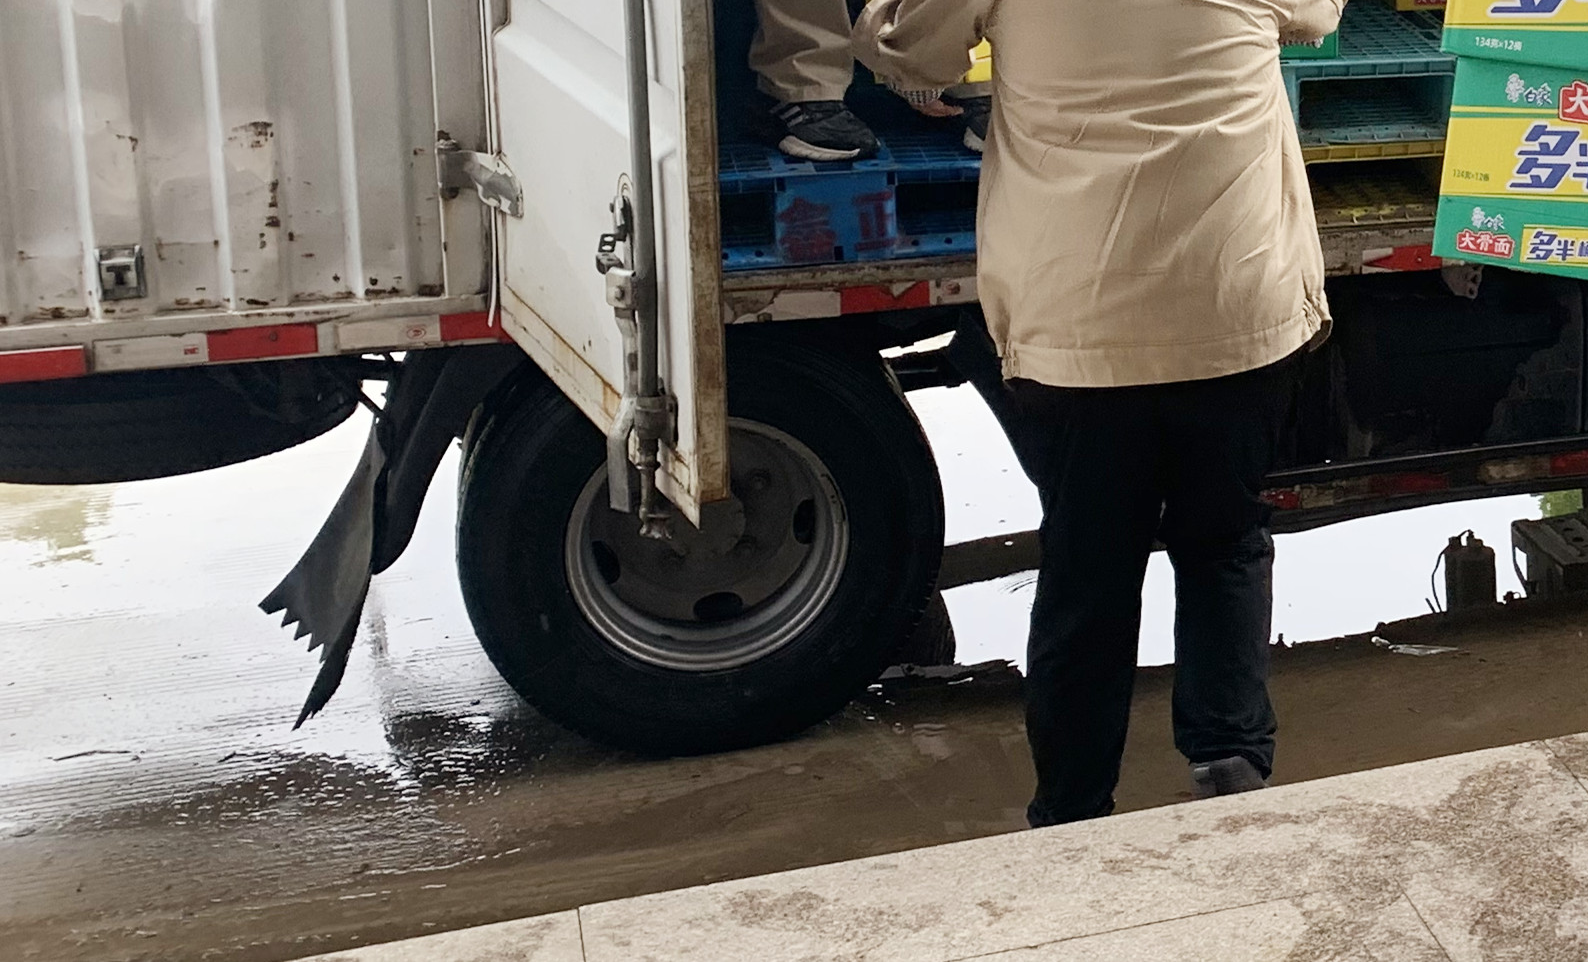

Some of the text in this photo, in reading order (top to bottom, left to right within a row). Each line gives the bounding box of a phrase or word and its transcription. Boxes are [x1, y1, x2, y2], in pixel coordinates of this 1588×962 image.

[1524, 81, 1553, 108] 白象
[1460, 230, 1512, 256] 大骨面
